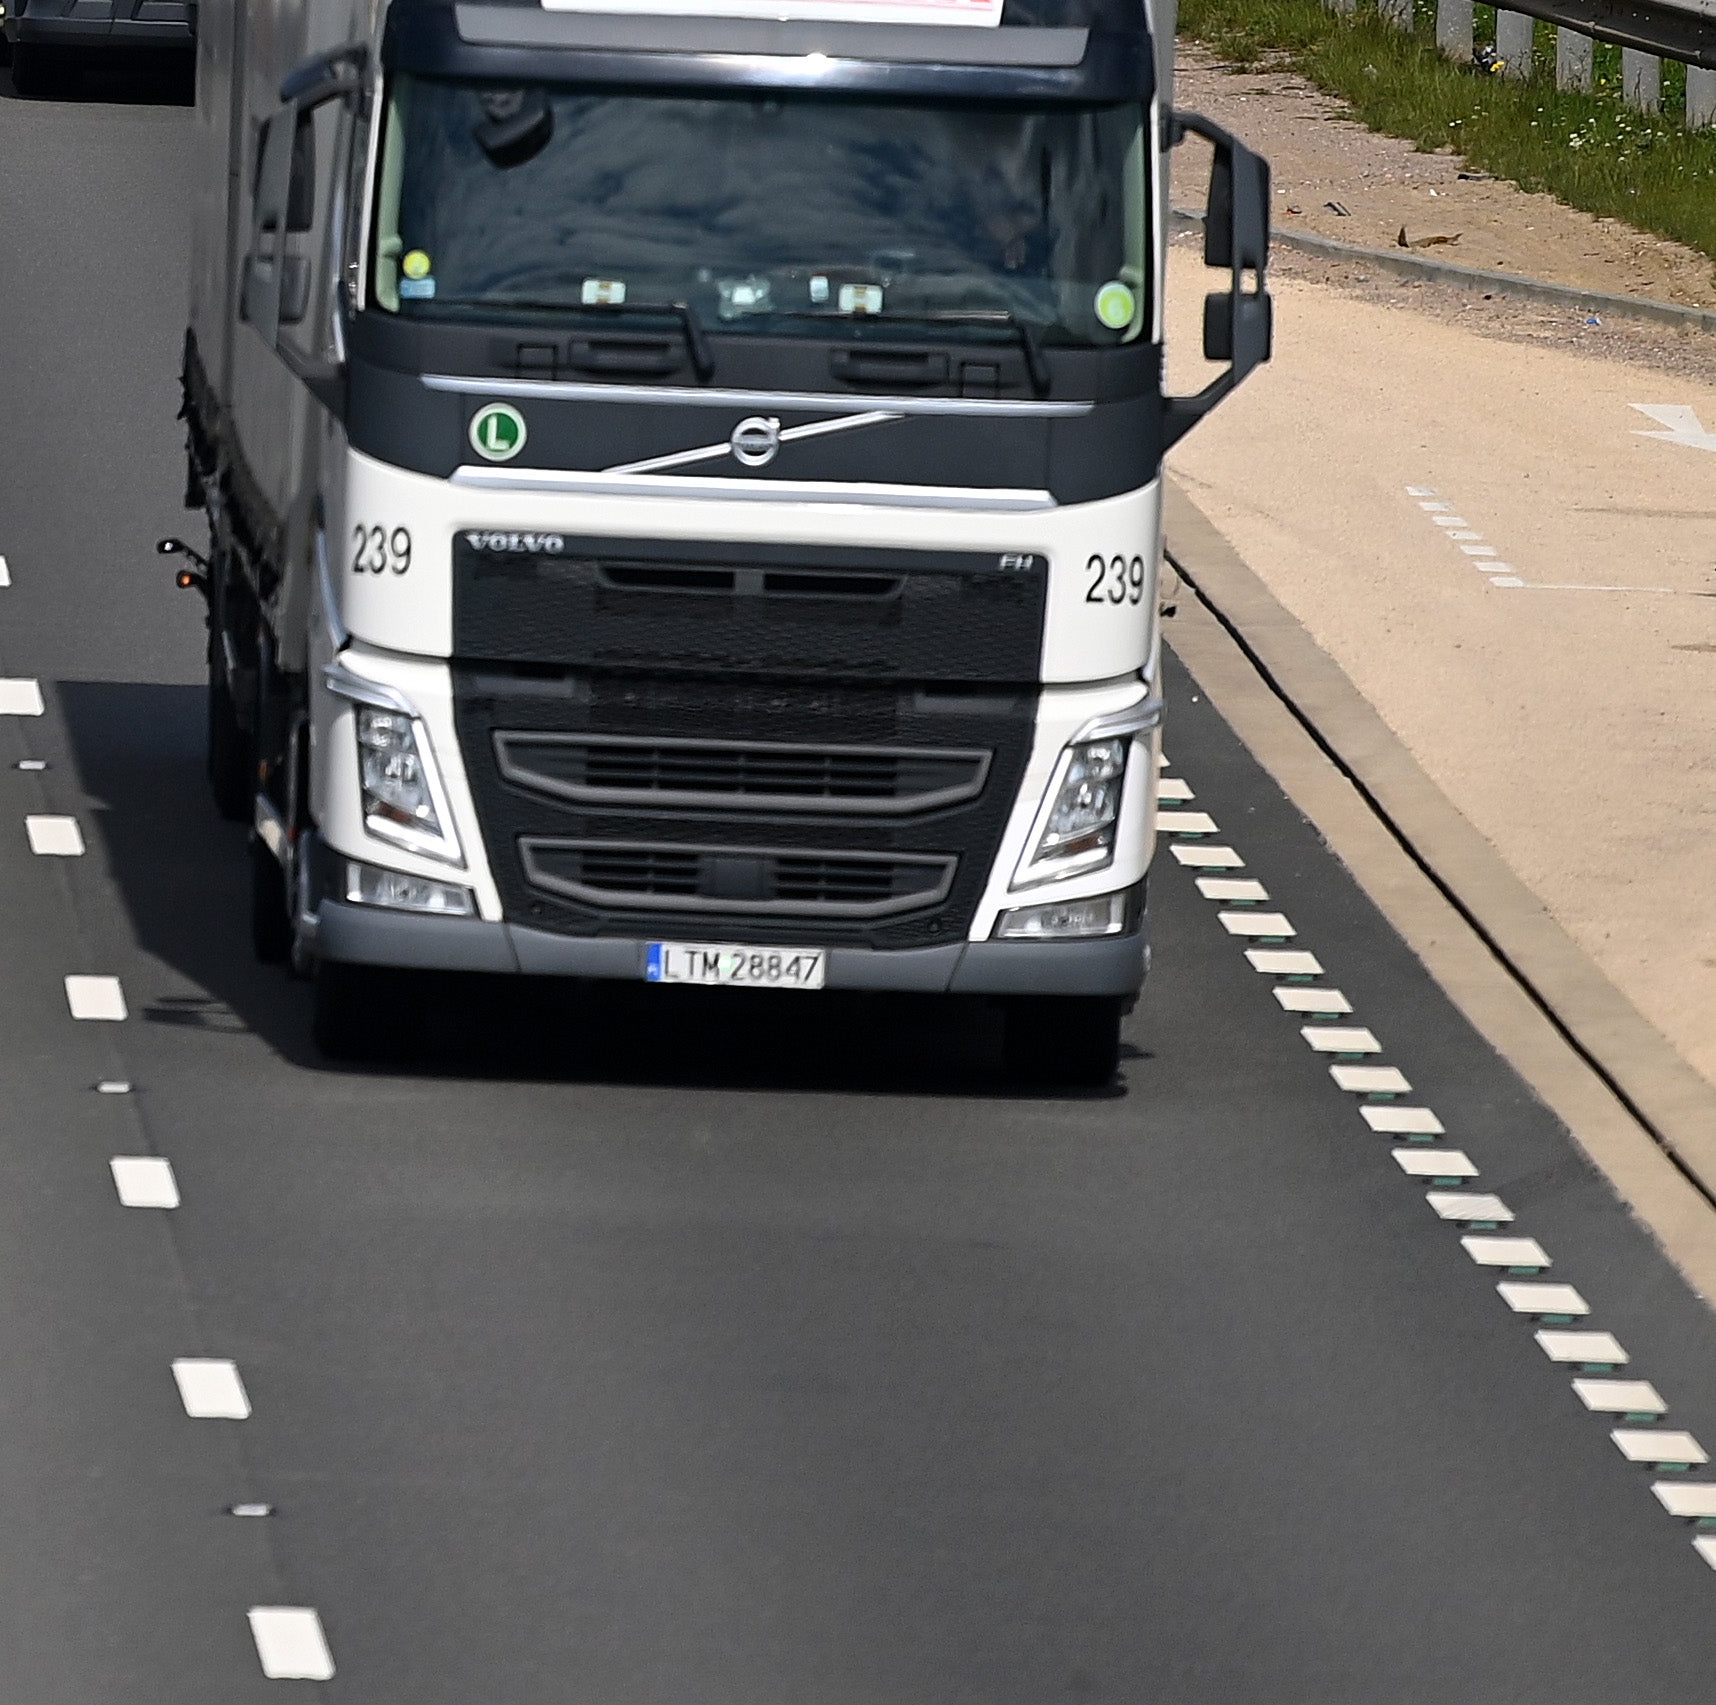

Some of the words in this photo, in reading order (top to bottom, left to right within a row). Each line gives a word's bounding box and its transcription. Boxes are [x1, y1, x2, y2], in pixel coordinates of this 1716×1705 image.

[486, 414, 510, 450] L
[352, 523, 412, 575] 239
[465, 531, 565, 554] VOLVO
[1085, 553, 1145, 605] 239
[664, 949, 721, 979] LTM
[730, 949, 821, 983] 28847
